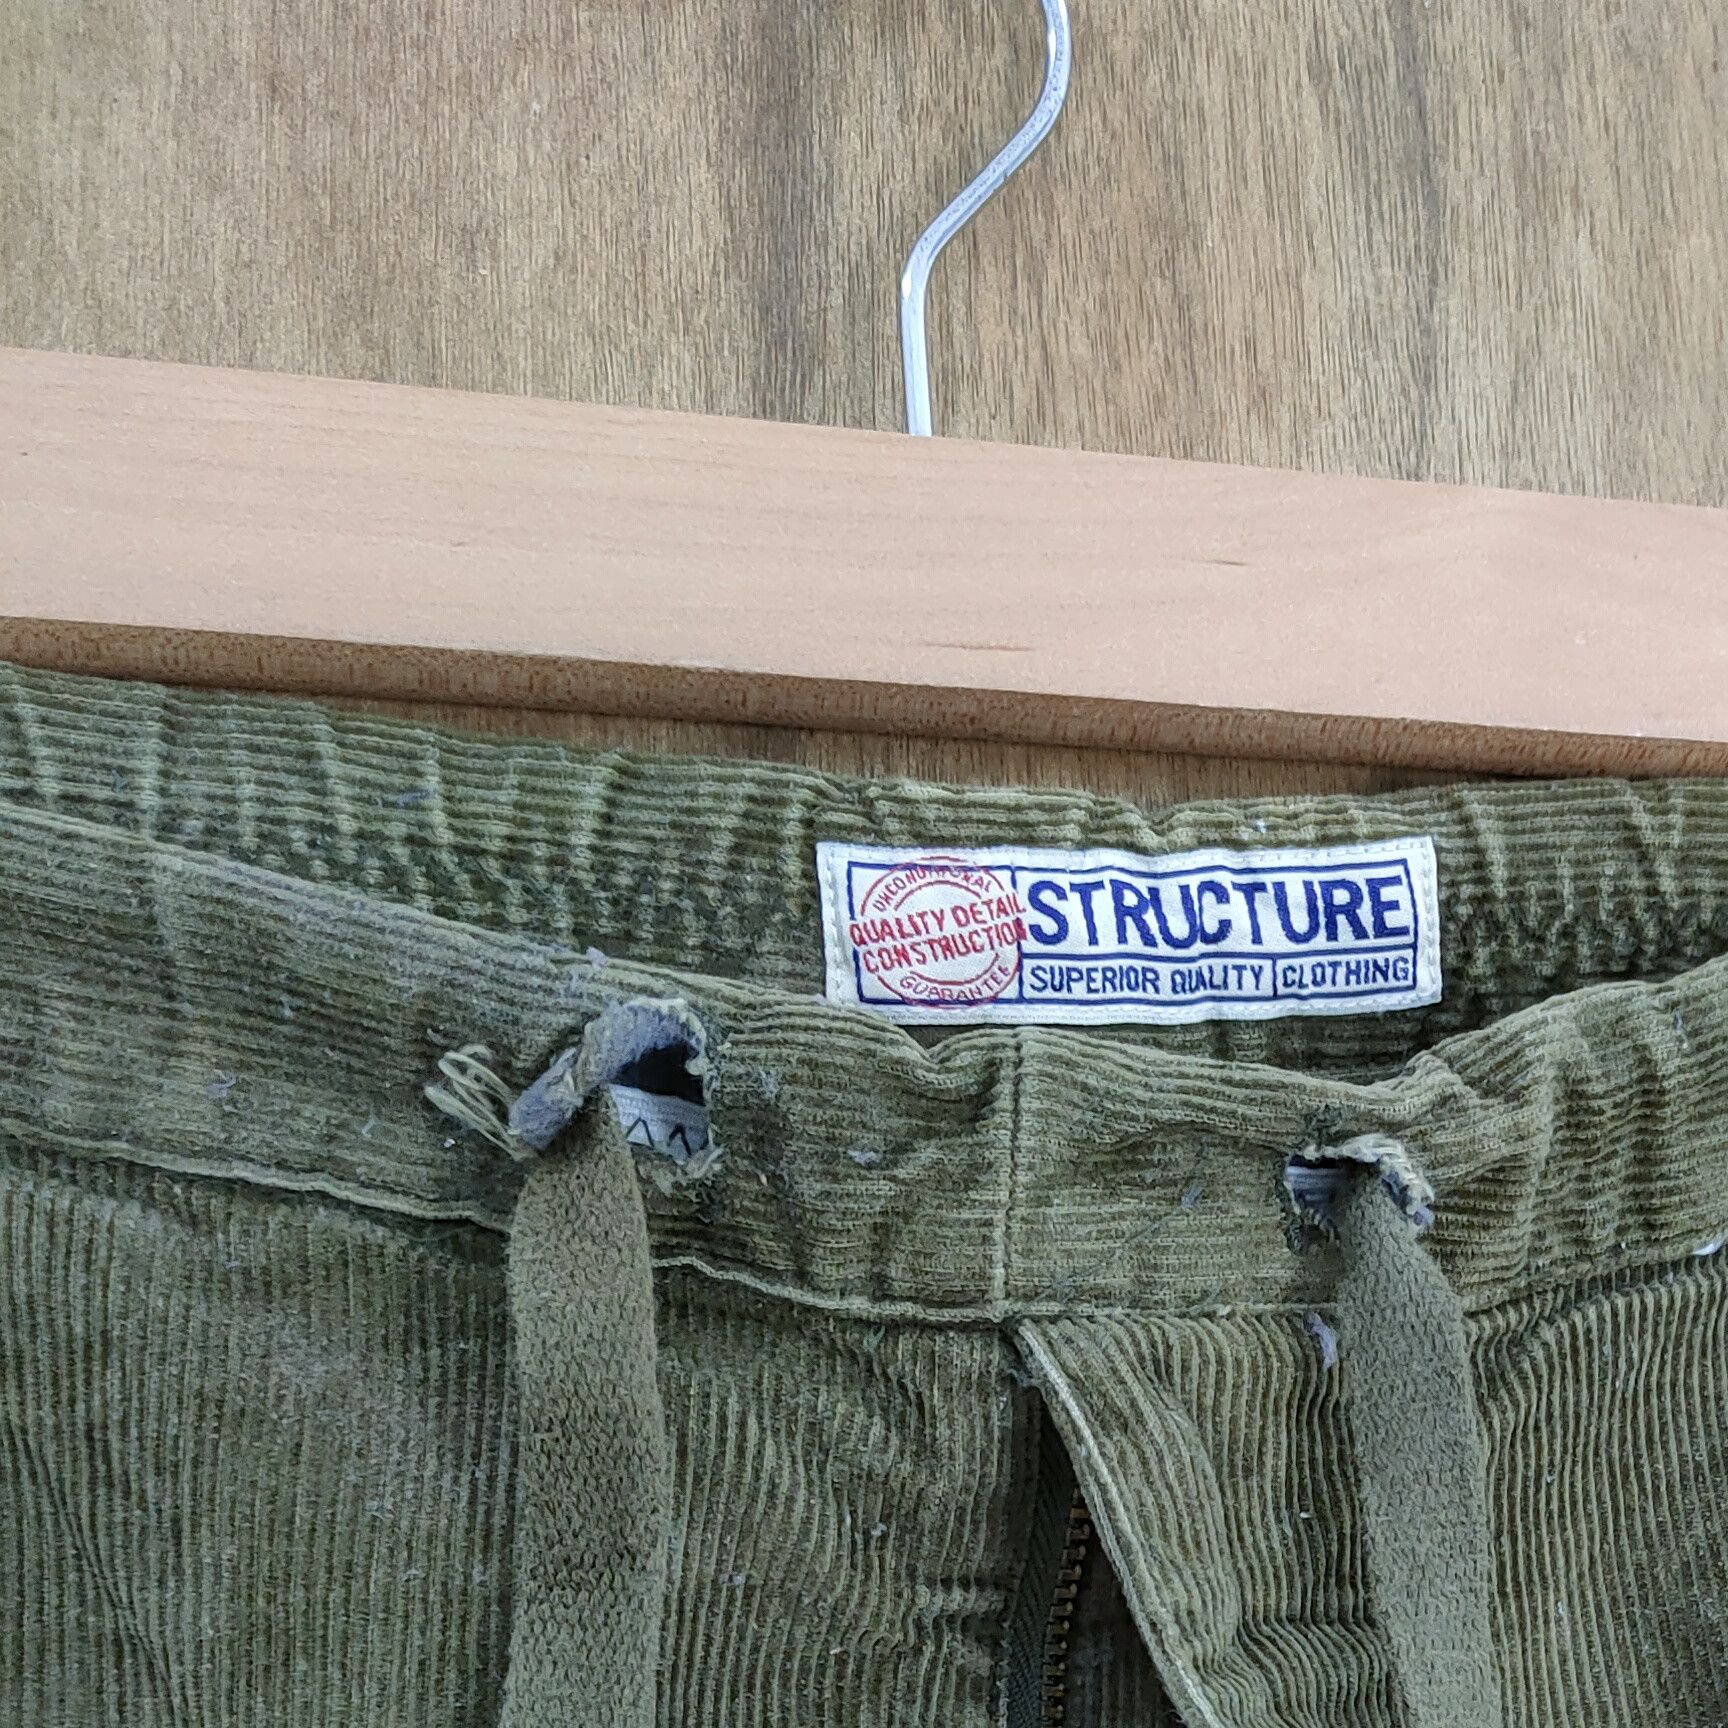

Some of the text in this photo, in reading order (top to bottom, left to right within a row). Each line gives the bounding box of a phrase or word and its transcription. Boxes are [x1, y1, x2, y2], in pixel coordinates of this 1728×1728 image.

[850, 893, 1026, 947] QUALITY DETAIL
[1028, 875, 1410, 949] STRUCTURE
[862, 917, 1027, 974] CONSTRUCTION
[1029, 956, 1410, 995] SUPERIOR QUALITY CLOTHING
